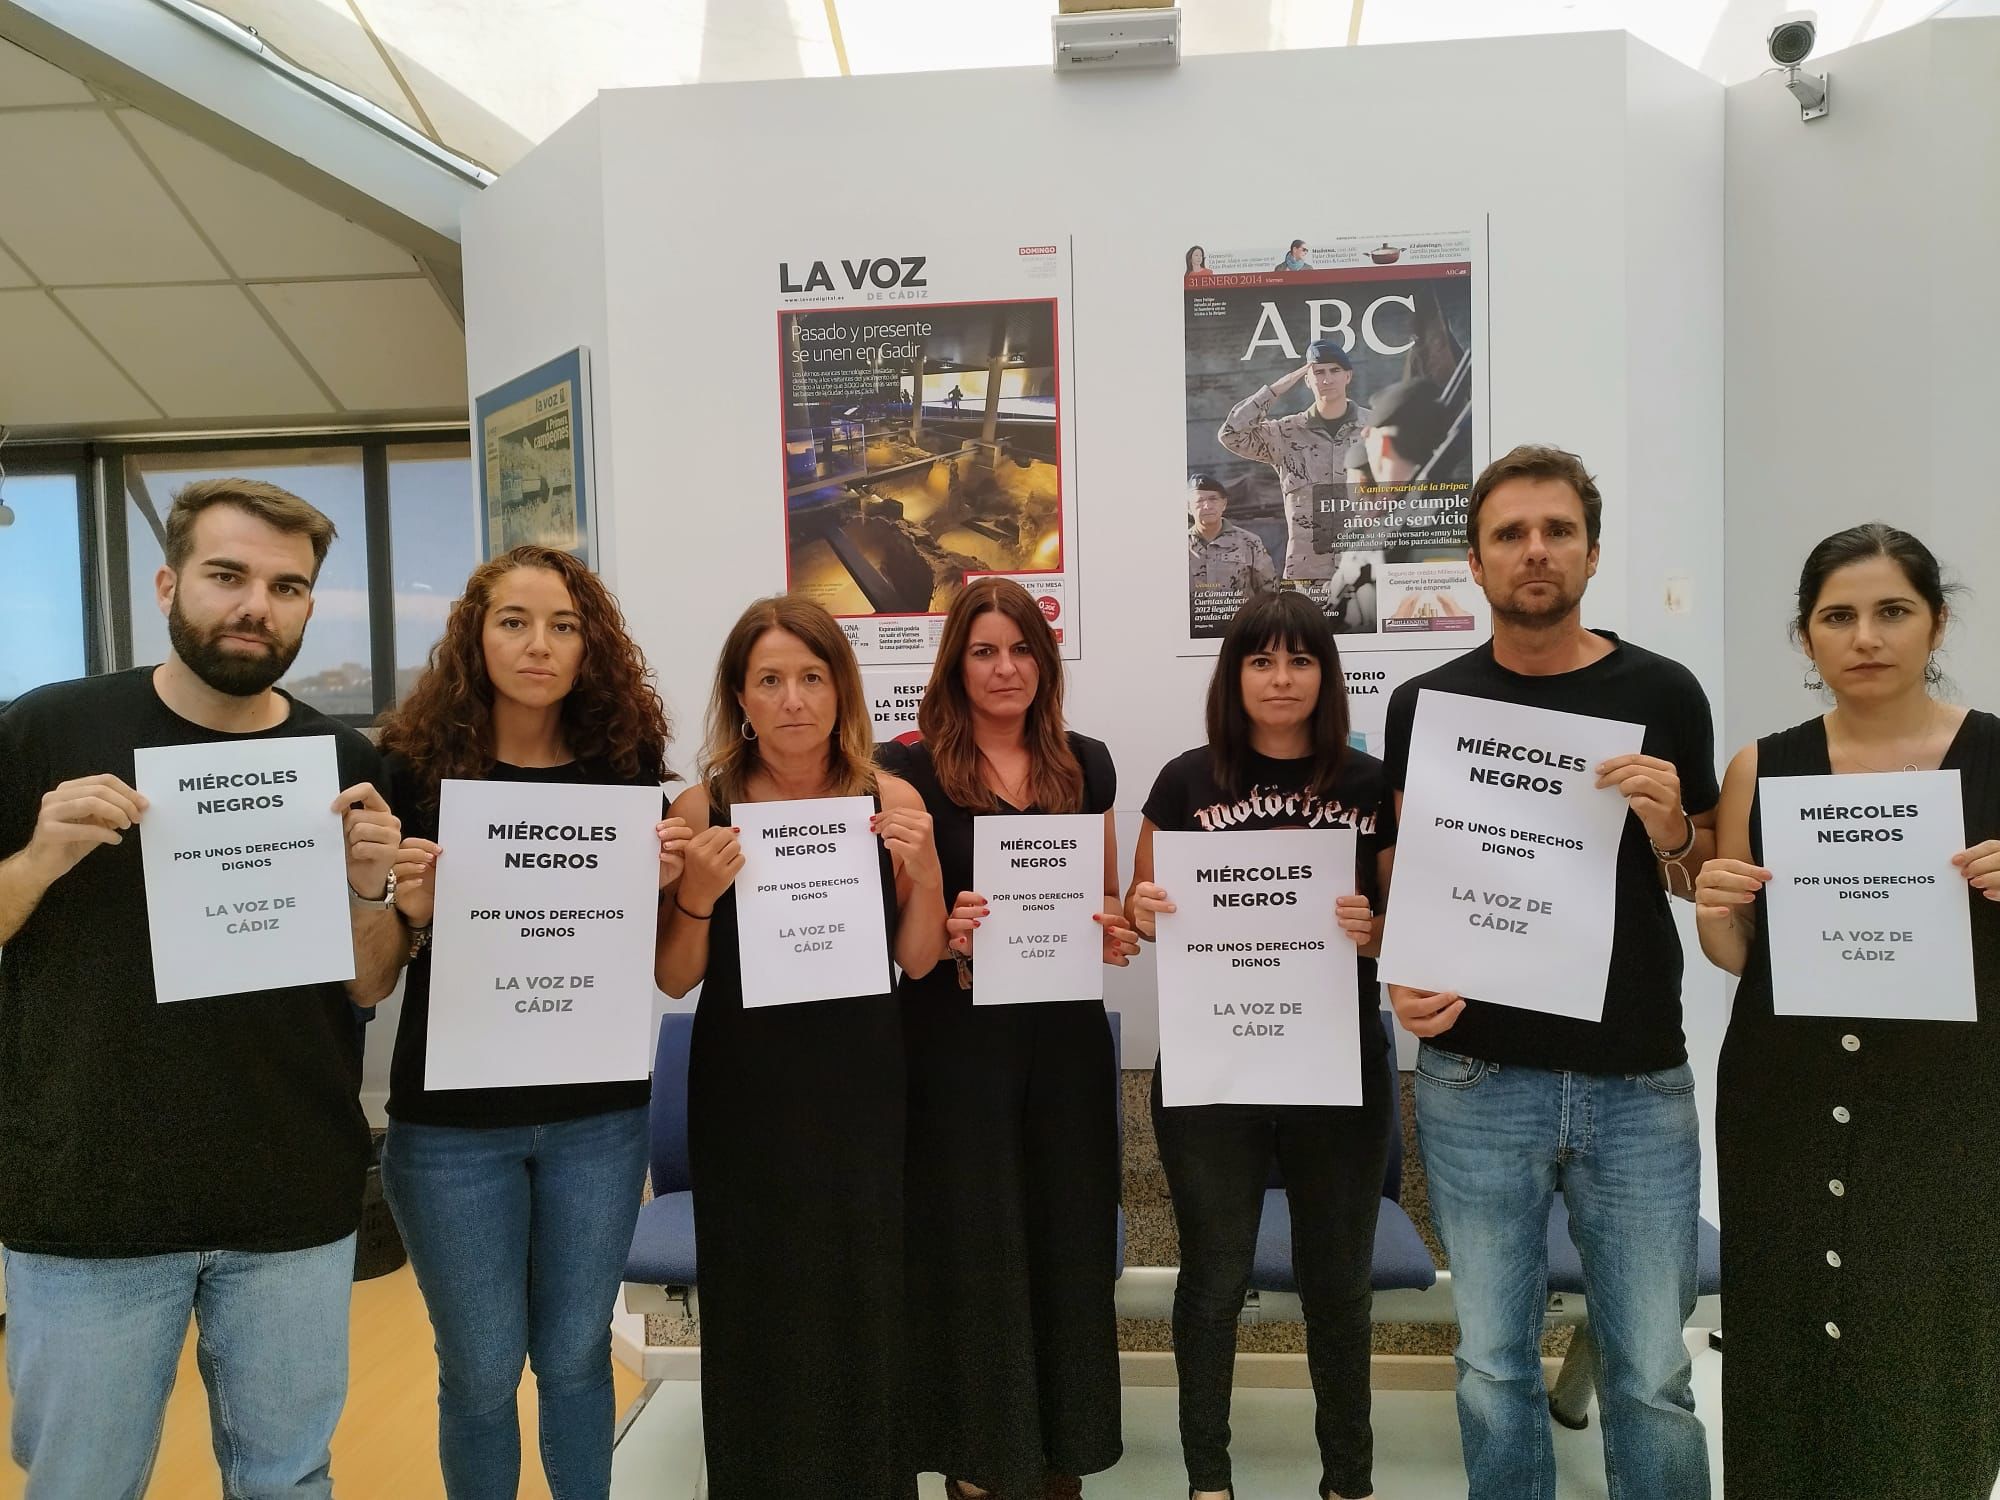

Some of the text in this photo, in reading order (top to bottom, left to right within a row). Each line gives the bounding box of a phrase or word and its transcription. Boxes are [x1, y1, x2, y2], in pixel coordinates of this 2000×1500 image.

[780, 257, 927, 293] LA VOZ
[1189, 278, 1198, 287] 31
[1201, 276, 1238, 287] ENERO
[1240, 275, 1262, 285] 2014
[867, 289, 928, 301] DE CÁDIZ
[792, 322, 932, 343] Pasado y presente
[1241, 294, 1416, 361] ABC
[792, 340, 920, 363] se unen en Gadir
[534, 425, 569, 448] campeones
[1366, 484, 1416, 493] aniversario
[1440, 483, 1469, 492] Bripac
[1319, 494, 1469, 513] El Príncipe cumple
[1343, 511, 1468, 528] años de servicio
[1337, 532, 1365, 540] Celebra
[1384, 539, 1397, 547] por
[1399, 538, 1409, 546] los
[1411, 537, 1460, 547] paracaidistas
[1427, 577, 1467, 585] tranquilidad
[1204, 590, 1234, 598] Cámara
[1234, 589, 1244, 597] de
[1195, 613, 1221, 621] ayudas
[875, 699, 891, 708] LA
[874, 713, 919, 722] DE SEG
[1456, 736, 1587, 773] MIÉRCOLES
[178, 769, 298, 792] MIÉRCOLES
[1469, 766, 1564, 796] NEGROS
[197, 794, 284, 815] NEGROS
[1799, 803, 1919, 821] MIÉRCOLES
[487, 820, 617, 842] MIÉRCOLES
[762, 822, 847, 840] MIÉRCOLES
[1434, 817, 1584, 852] POR UNOS DERECHOS
[1817, 828, 1904, 844] NEGROS
[173, 839, 315, 862] POR UNOS DERECHOS
[775, 842, 837, 857] NEGROS
[1000, 837, 1078, 851] MIÉRCOLES
[1481, 841, 1537, 860] DIGNOS
[221, 858, 272, 872] DIGNOS
[504, 852, 599, 870] NEGROS
[1010, 857, 1067, 869] NEGROS
[1196, 864, 1313, 883] MIÉRCOLES
[1793, 875, 1936, 886] POR UNOS DERECHOS
[757, 877, 860, 893] POR UNOS DERECHOS
[791, 891, 828, 902] DIGNOS
[1012, 893, 1037, 901] UNOS
[1038, 892, 1085, 900] DERECHOS
[1212, 891, 1298, 908] NEGROS
[1451, 886, 1553, 915] LA VOZ DE
[1839, 890, 1890, 900] DIGNOS
[205, 896, 297, 918] LA VOZ DE
[470, 909, 624, 920] POR UNOS DERECHOS
[1022, 903, 1055, 912] DIGNOS
[226, 918, 280, 935] CÁDIZ
[1468, 909, 1529, 934] CÁDIZ
[520, 927, 576, 938] DIGNOS
[779, 922, 846, 939] LA VOZ DE
[1822, 930, 1913, 942] LA VOZ DE
[793, 940, 833, 953] CÁDIZ
[1008, 934, 1068, 945] LA VOZ DE
[1187, 940, 1325, 953] POR UNOS DERECHOS
[1020, 947, 1056, 959] CÁDIZ
[1841, 947, 1896, 962] CÁDIZ
[1231, 957, 1281, 968] DIGNOS
[495, 975, 595, 991] LA VOZ DE
[514, 996, 574, 1014] CÁDIZ
[1213, 1002, 1303, 1016] LA VOZ DE
[1232, 1021, 1285, 1037] CÁDIZ
